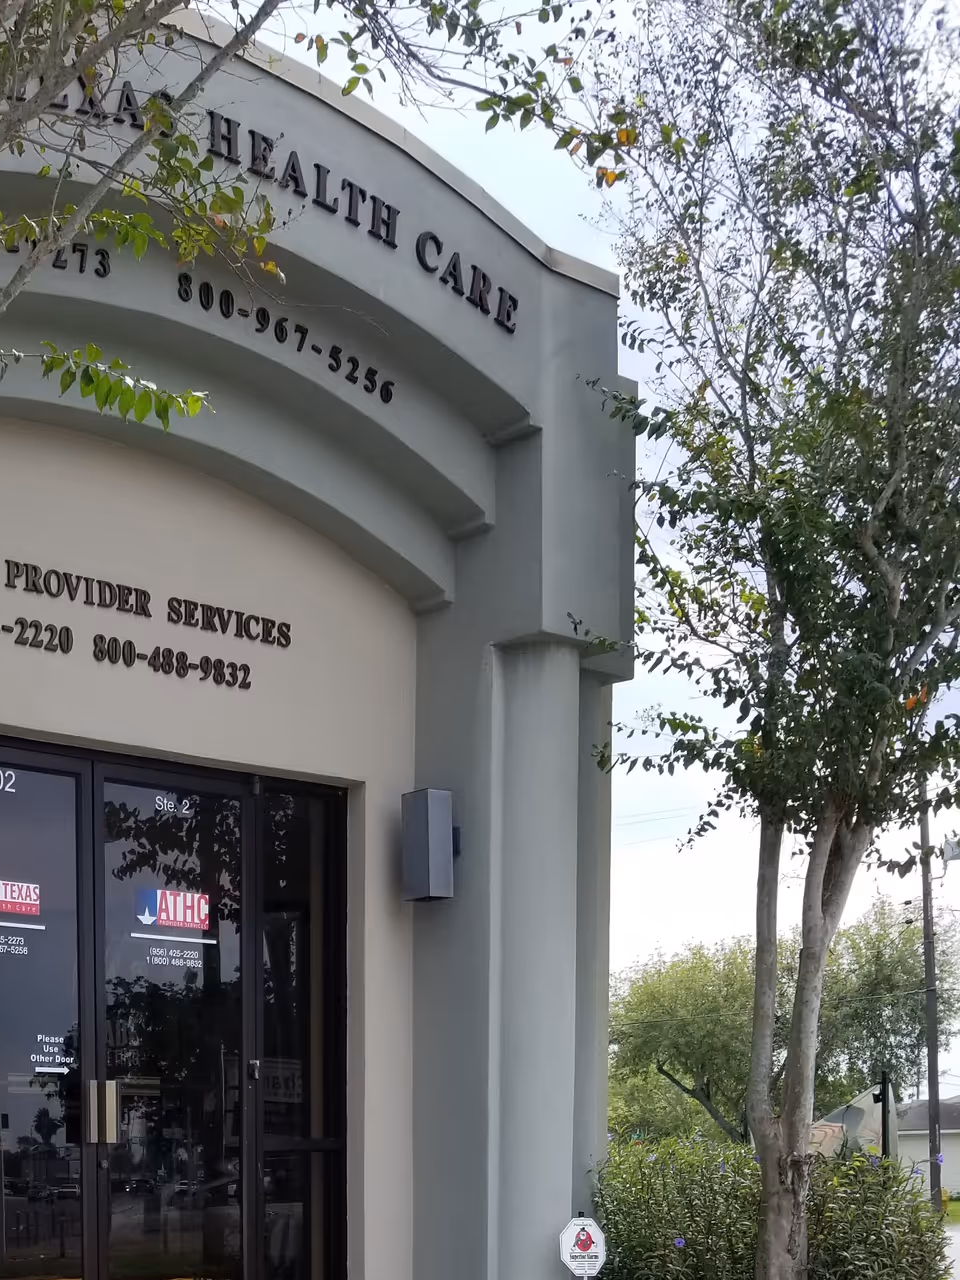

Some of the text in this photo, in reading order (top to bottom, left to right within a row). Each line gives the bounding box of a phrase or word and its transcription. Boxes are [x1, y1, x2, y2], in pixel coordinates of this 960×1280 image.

[206, 109, 401, 250] HEALTH
[415, 231, 519, 335] CARE
[177, 271, 395, 404] 800-967-5256
[5, 559, 152, 619] PROVIDER
[167, 596, 292, 648] SERVICES
[93, 634, 252, 690] 800-488-9832
[155, 796, 190, 814] Ste. 2
[2, 882, 39, 902] TEXAS
[16, 903, 36, 913] Care
[157, 890, 209, 924] ATHC
[160, 919, 207, 930] PROVIDER SERVICES
[149, 947, 199, 959] (956) 425-2220
[151, 956, 169, 966] (800)
[37, 1034, 64, 1045] Please
[42, 1044, 59, 1053] Use
[30, 1053, 74, 1064] Other Door
